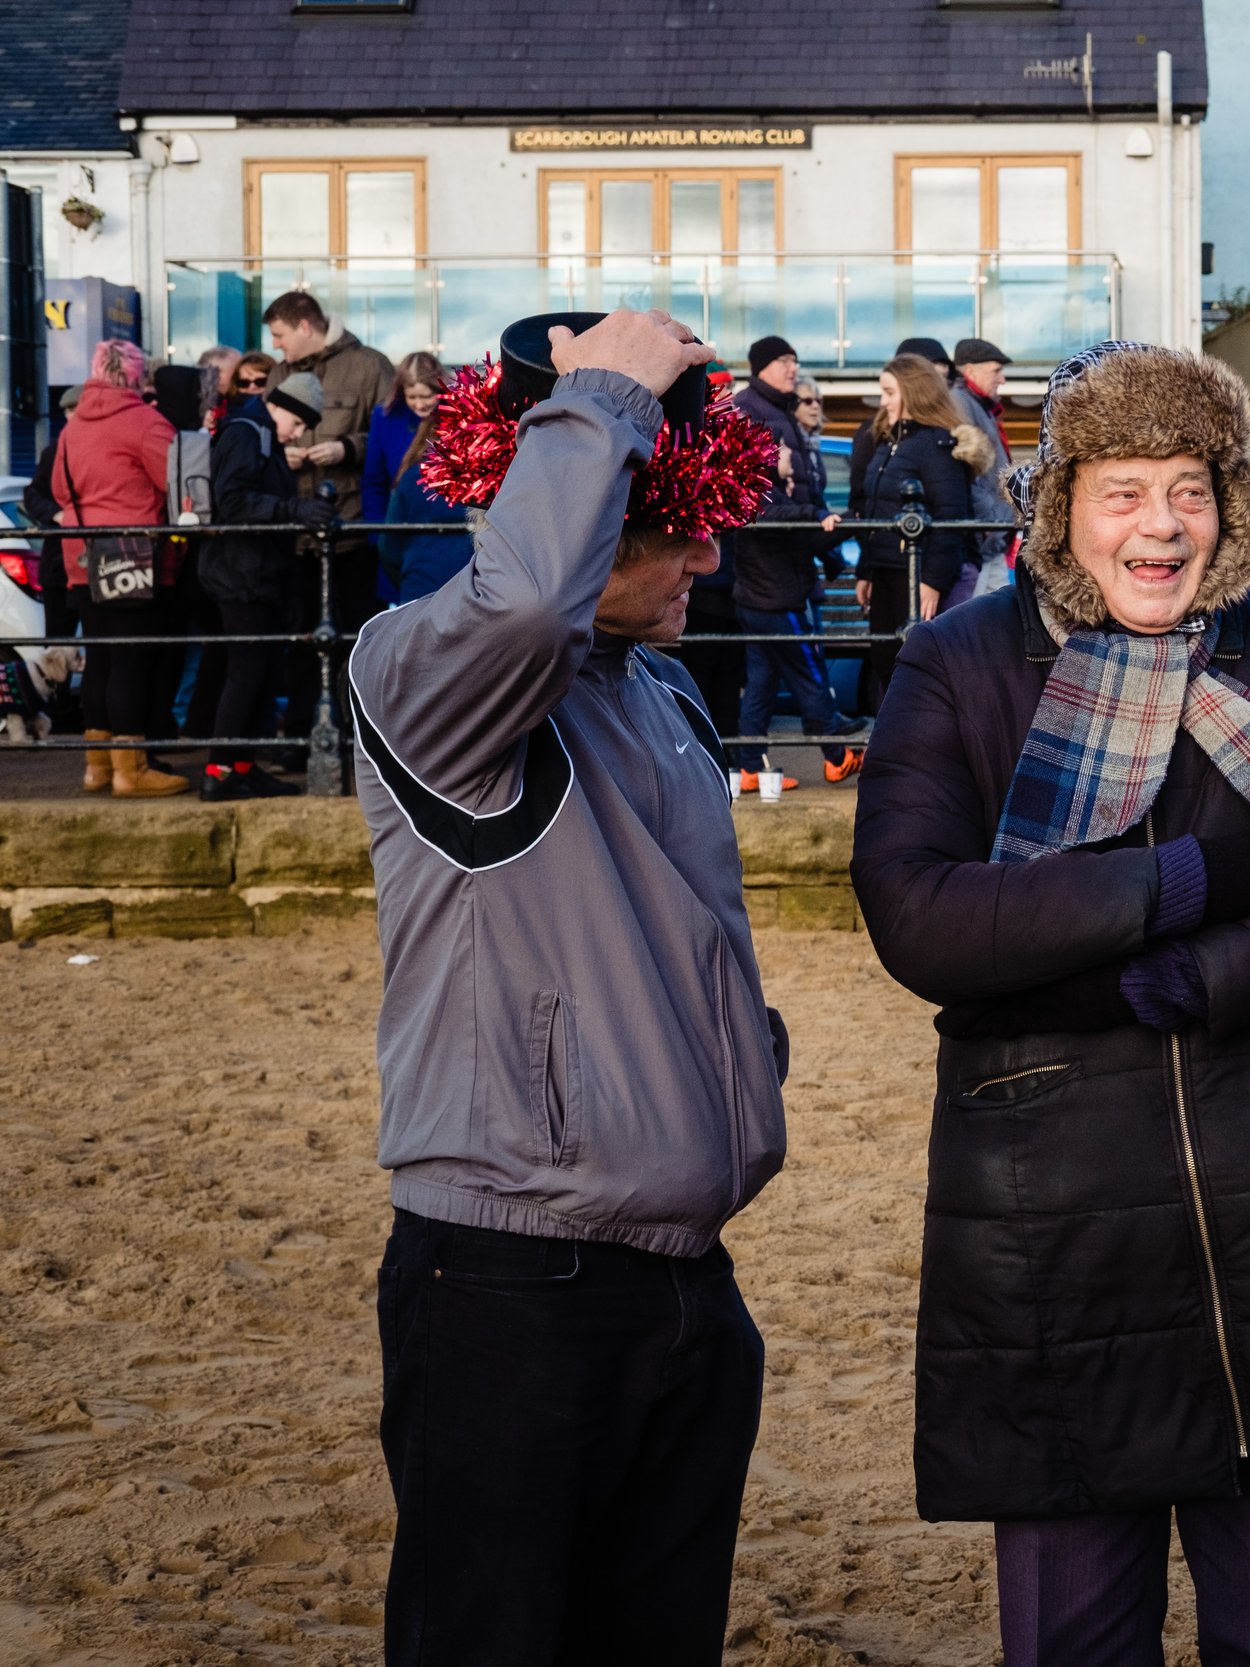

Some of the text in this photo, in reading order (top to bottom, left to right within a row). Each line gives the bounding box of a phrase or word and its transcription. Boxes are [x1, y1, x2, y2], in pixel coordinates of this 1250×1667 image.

[514, 128, 806, 147] SCARBOROUGH AMATEUR ROWING CLUB
